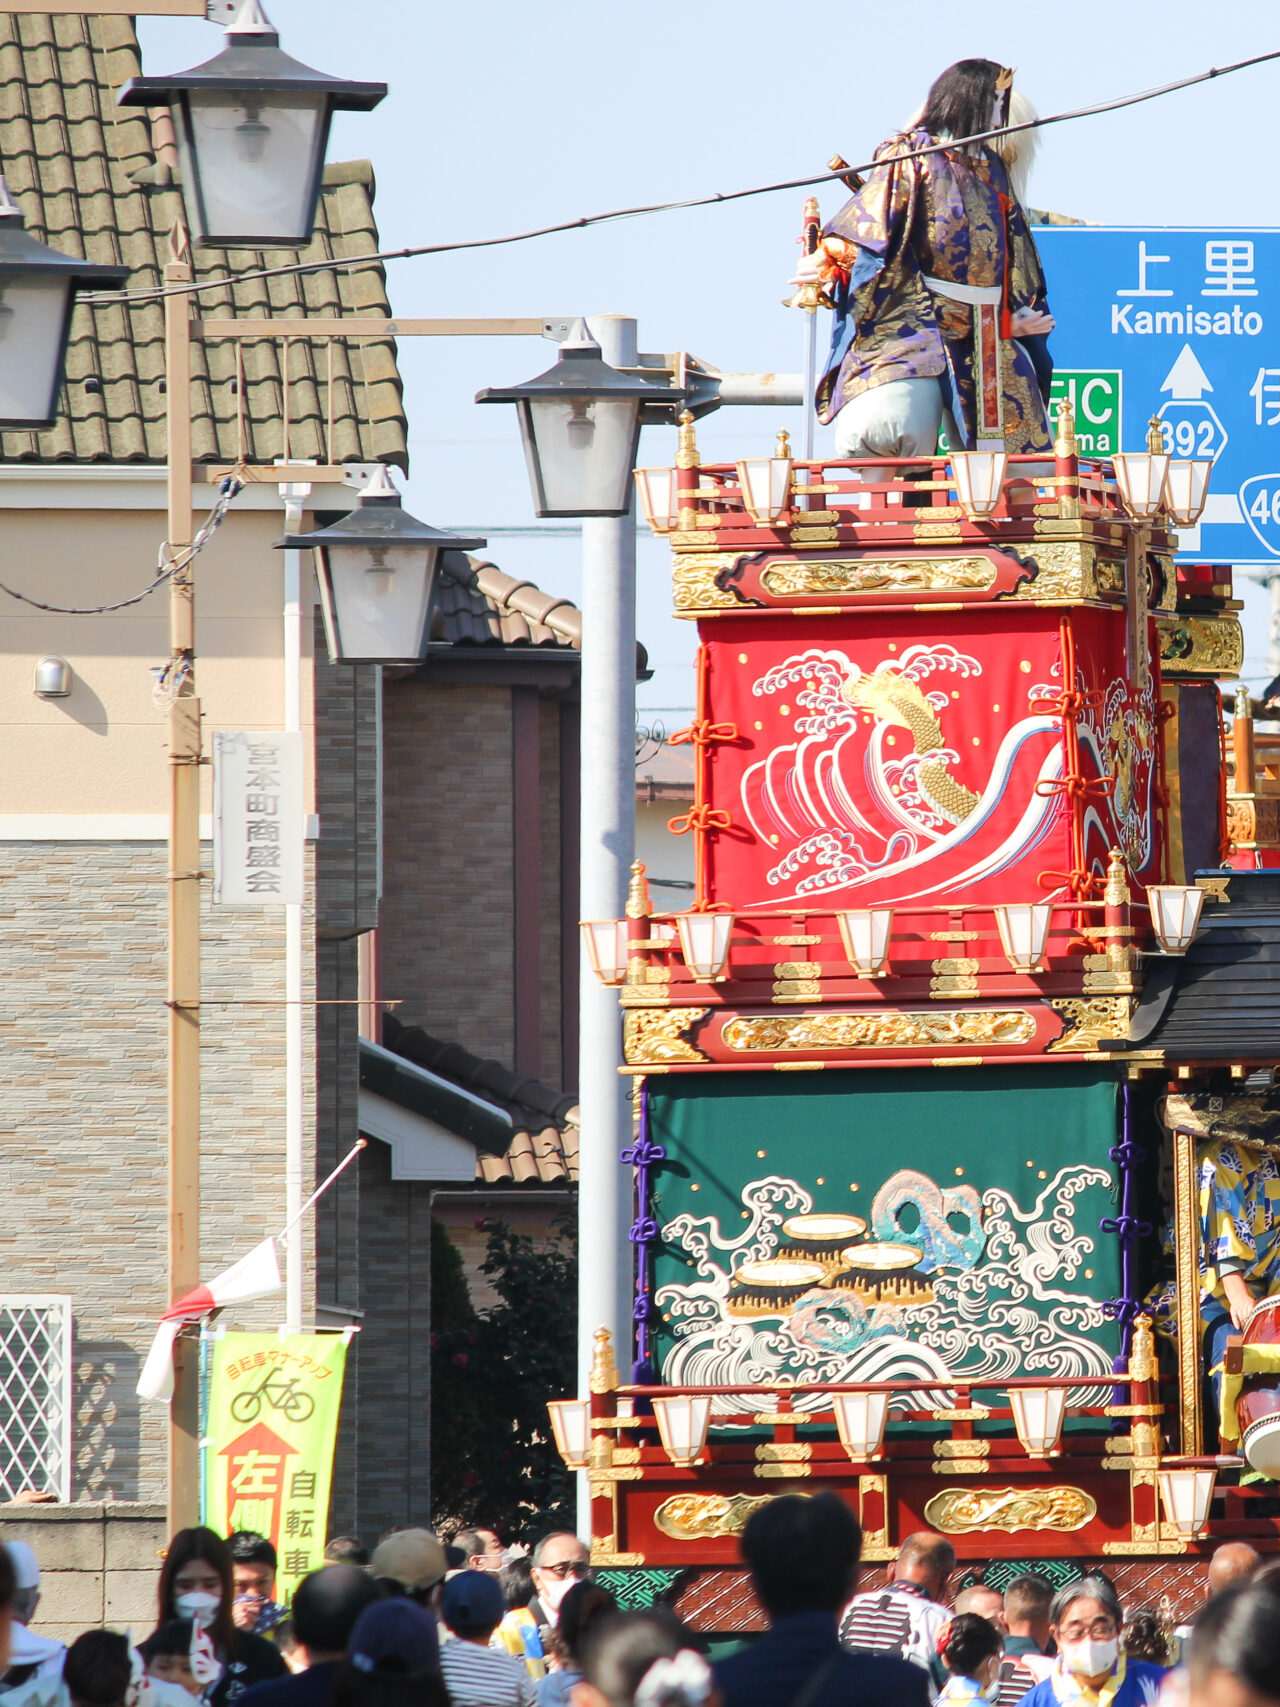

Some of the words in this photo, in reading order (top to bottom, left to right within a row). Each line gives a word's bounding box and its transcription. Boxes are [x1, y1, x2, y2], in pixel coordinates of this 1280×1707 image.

[1116, 240, 1259, 297] 上里
[1111, 304, 1263, 335] Kamisato
[245, 742, 281, 894] 宮本町商盛会
[282, 1469, 316, 1609] 自転車
